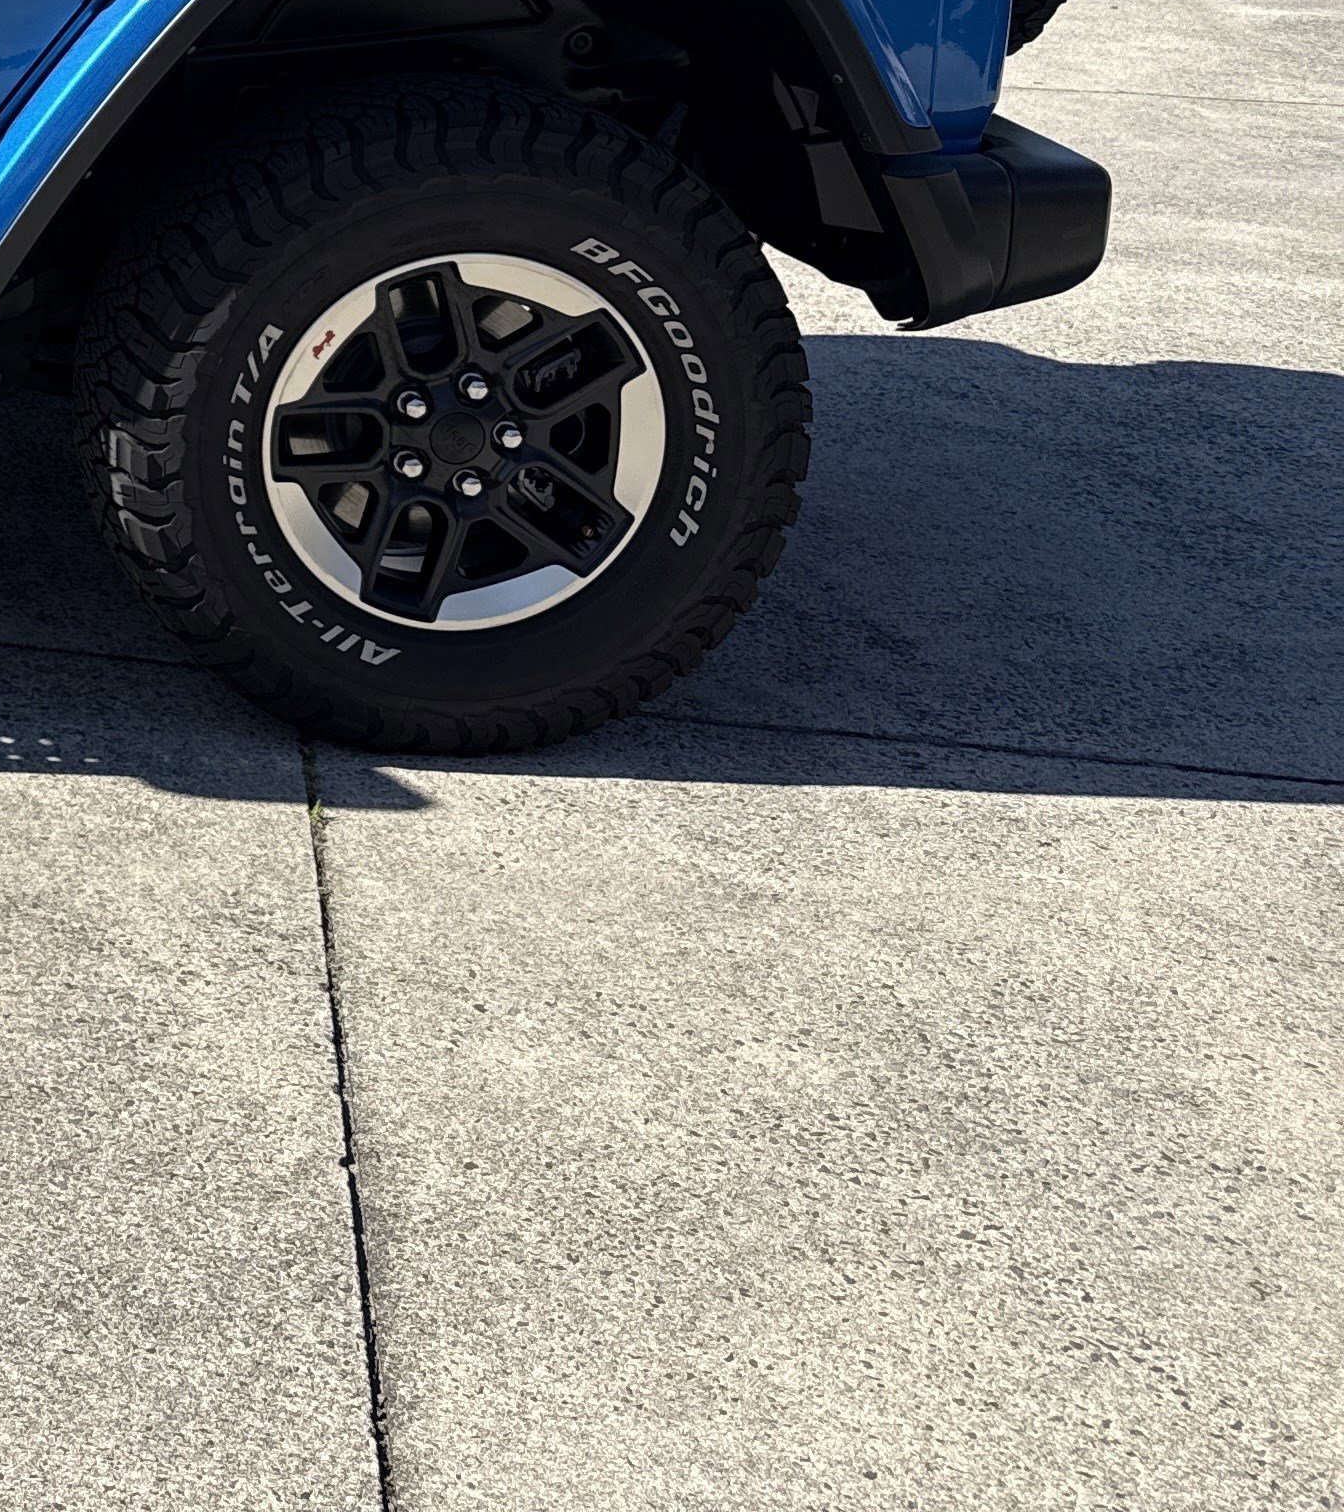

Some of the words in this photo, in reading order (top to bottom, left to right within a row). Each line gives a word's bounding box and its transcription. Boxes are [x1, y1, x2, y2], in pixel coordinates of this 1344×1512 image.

[230, 322, 285, 406] T/A
[569, 236, 721, 548] BFGoodrich
[221, 418, 402, 666] All-Terrain
